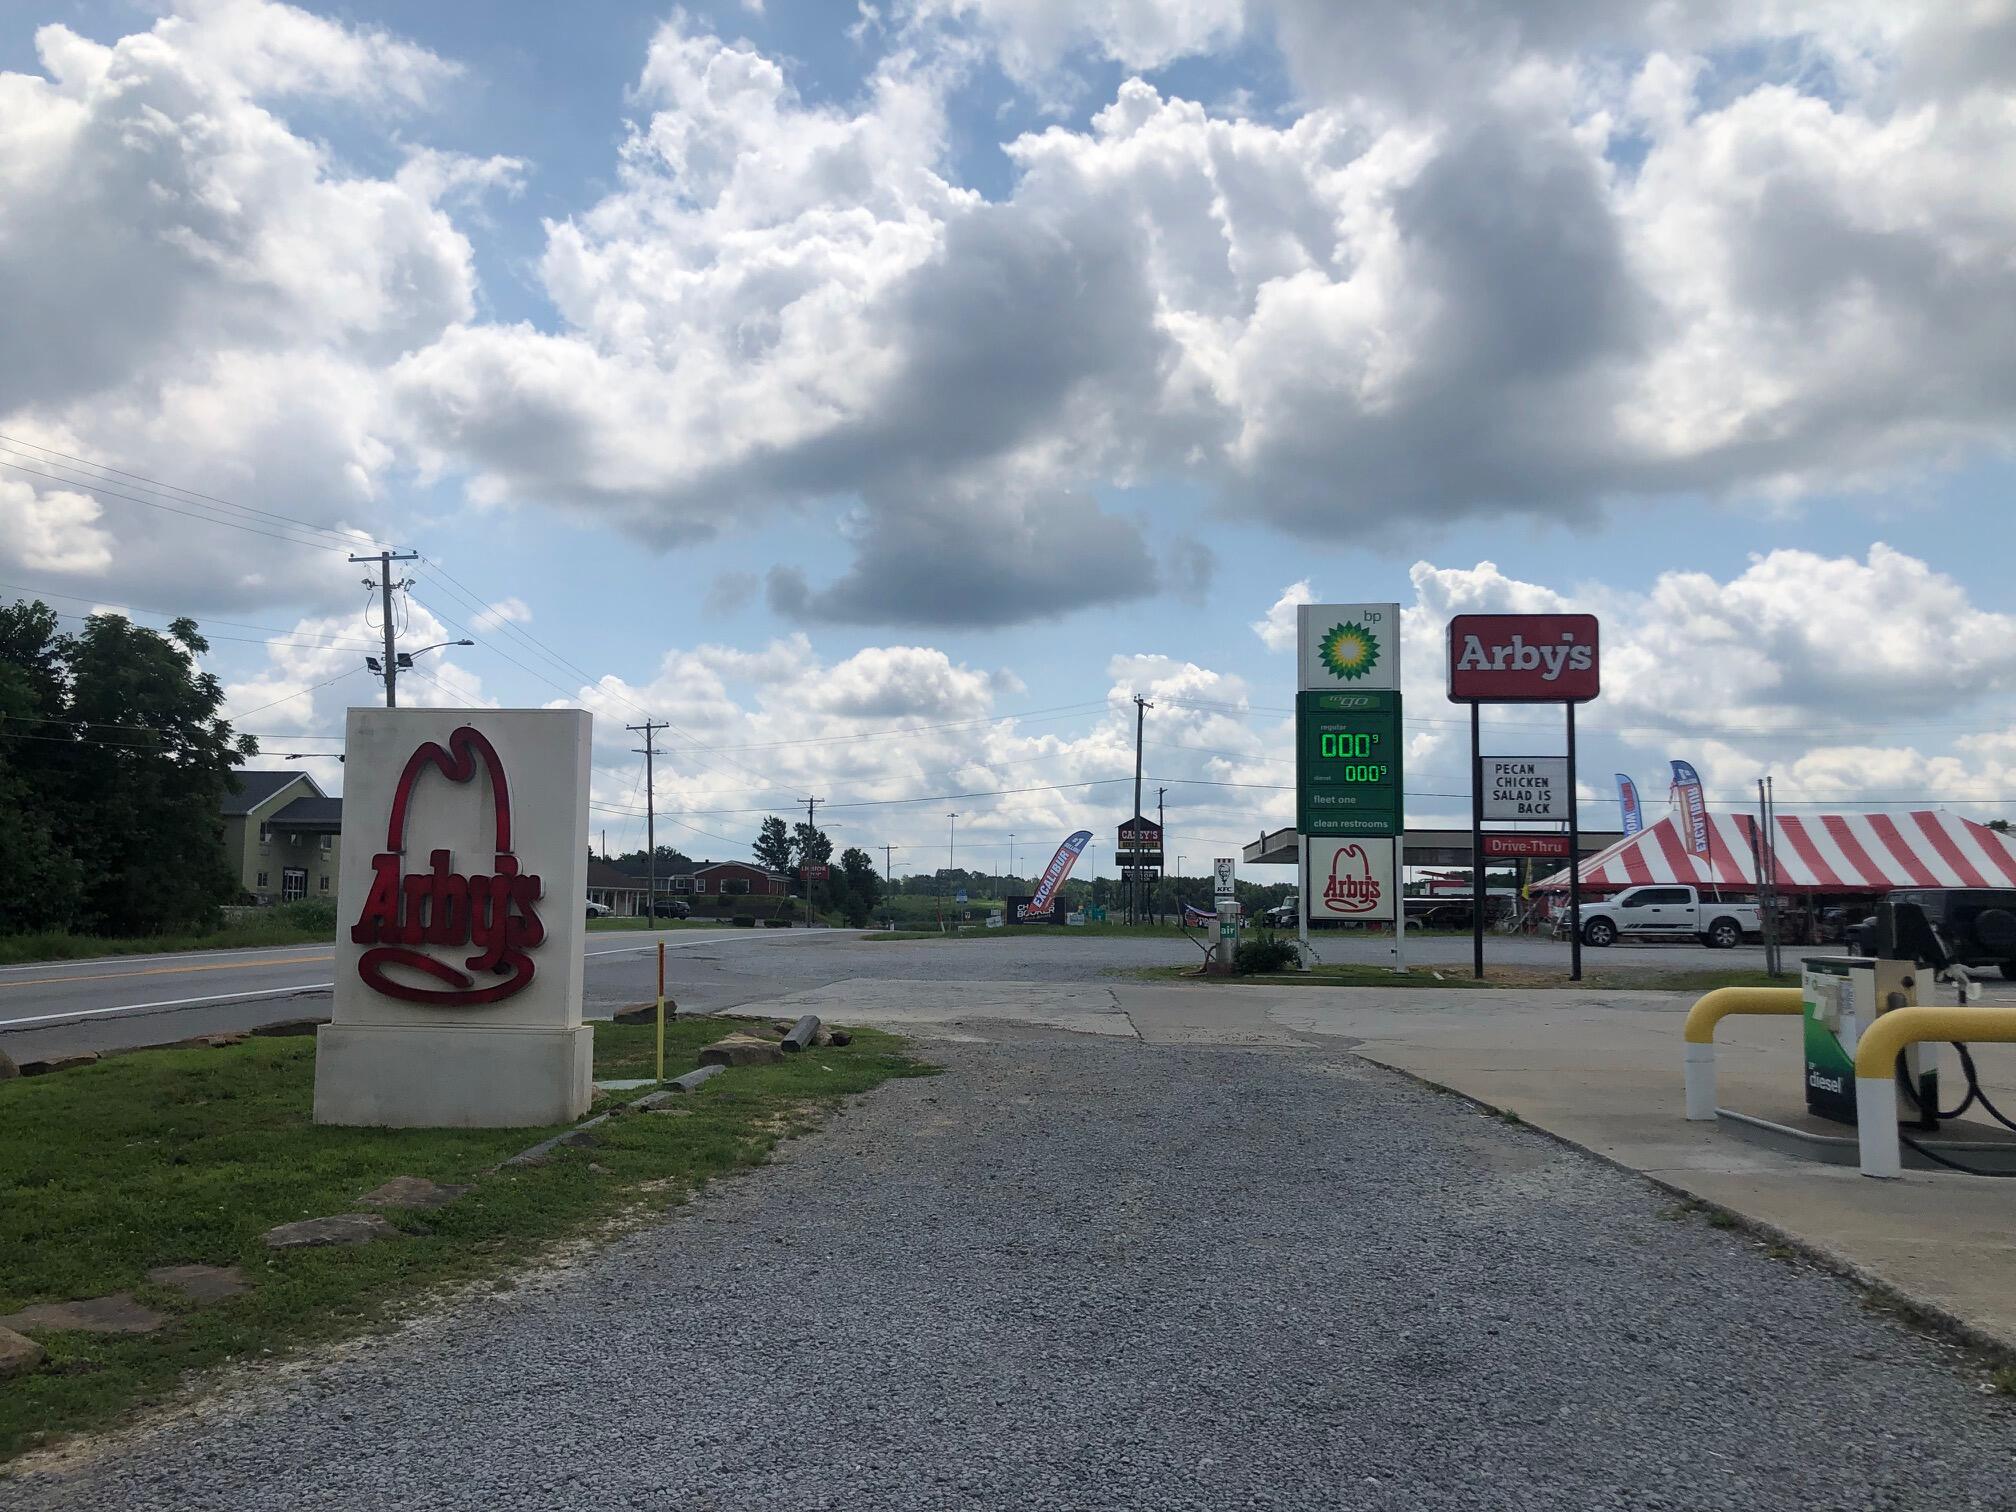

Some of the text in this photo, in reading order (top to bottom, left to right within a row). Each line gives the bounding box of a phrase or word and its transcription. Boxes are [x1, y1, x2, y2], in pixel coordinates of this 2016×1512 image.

[1364, 610, 1382, 624] bp
[1457, 632, 1592, 680] Arby's
[1340, 697, 1369, 708] go
[1320, 724, 1347, 732] regular
[1495, 764, 1535, 775] PECAN
[1496, 777, 1549, 788] CHICKEN
[1313, 795, 1356, 804] fleet one
[1493, 790, 1551, 801] SALAD IS
[1518, 803, 1550, 814] BACK
[1313, 820, 1388, 828] clean restrooms
[1492, 839, 1562, 852] Drive-Thru
[1032, 849, 1070, 909] EXCALIBUR
[1323, 874, 1381, 904] Arby's
[351, 849, 546, 970] Arby's
[1221, 925, 1234, 935] air
[1809, 1071, 1842, 1094] diesel
